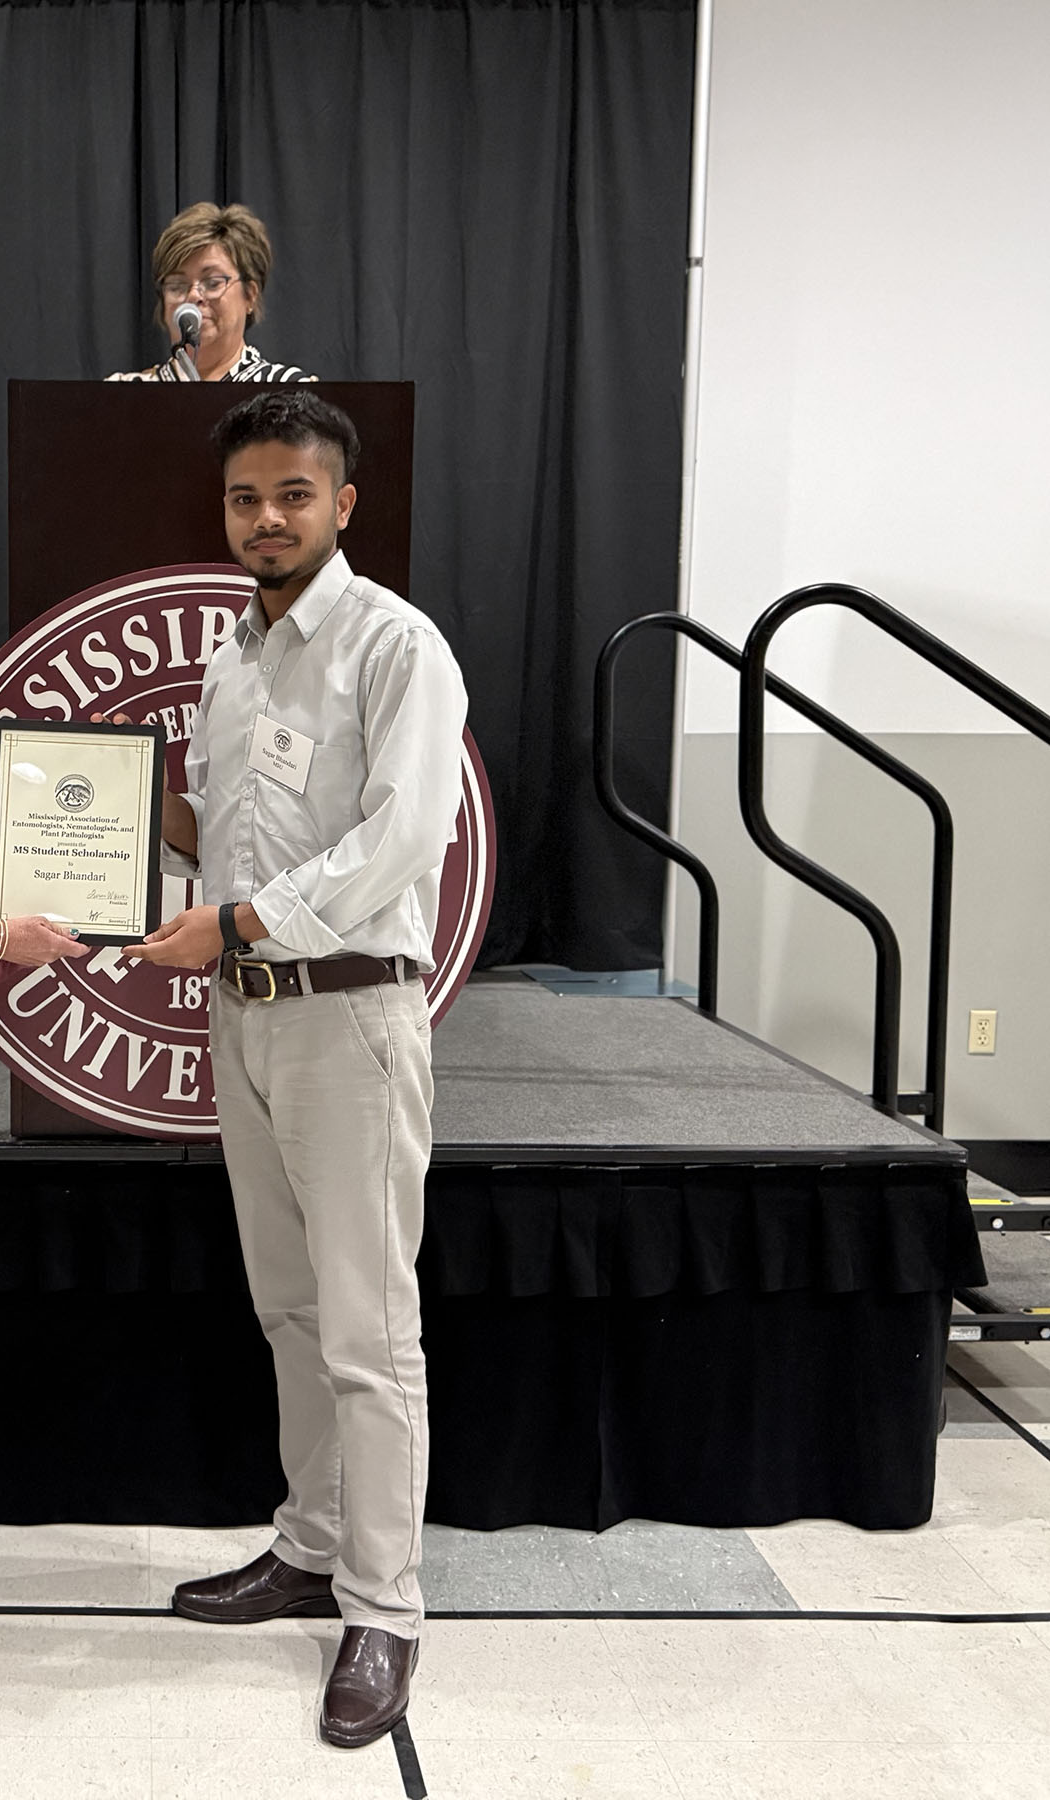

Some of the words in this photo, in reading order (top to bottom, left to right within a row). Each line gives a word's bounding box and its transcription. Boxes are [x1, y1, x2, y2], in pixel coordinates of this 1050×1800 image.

[28, 813, 68, 822] Mississippi
[69, 815, 110, 823] Association
[12, 821, 65, 830] Entomologists,
[66, 823, 119, 833] Nematologists,
[61, 831, 105, 840] Pathologists
[13, 846, 29, 854] MS
[31, 847, 69, 856] Student
[71, 848, 130, 861] Scholarship
[33, 869, 61, 881] Sagar
[63, 871, 106, 882] Bhandari
[7, 963, 216, 1102] UNIVE
